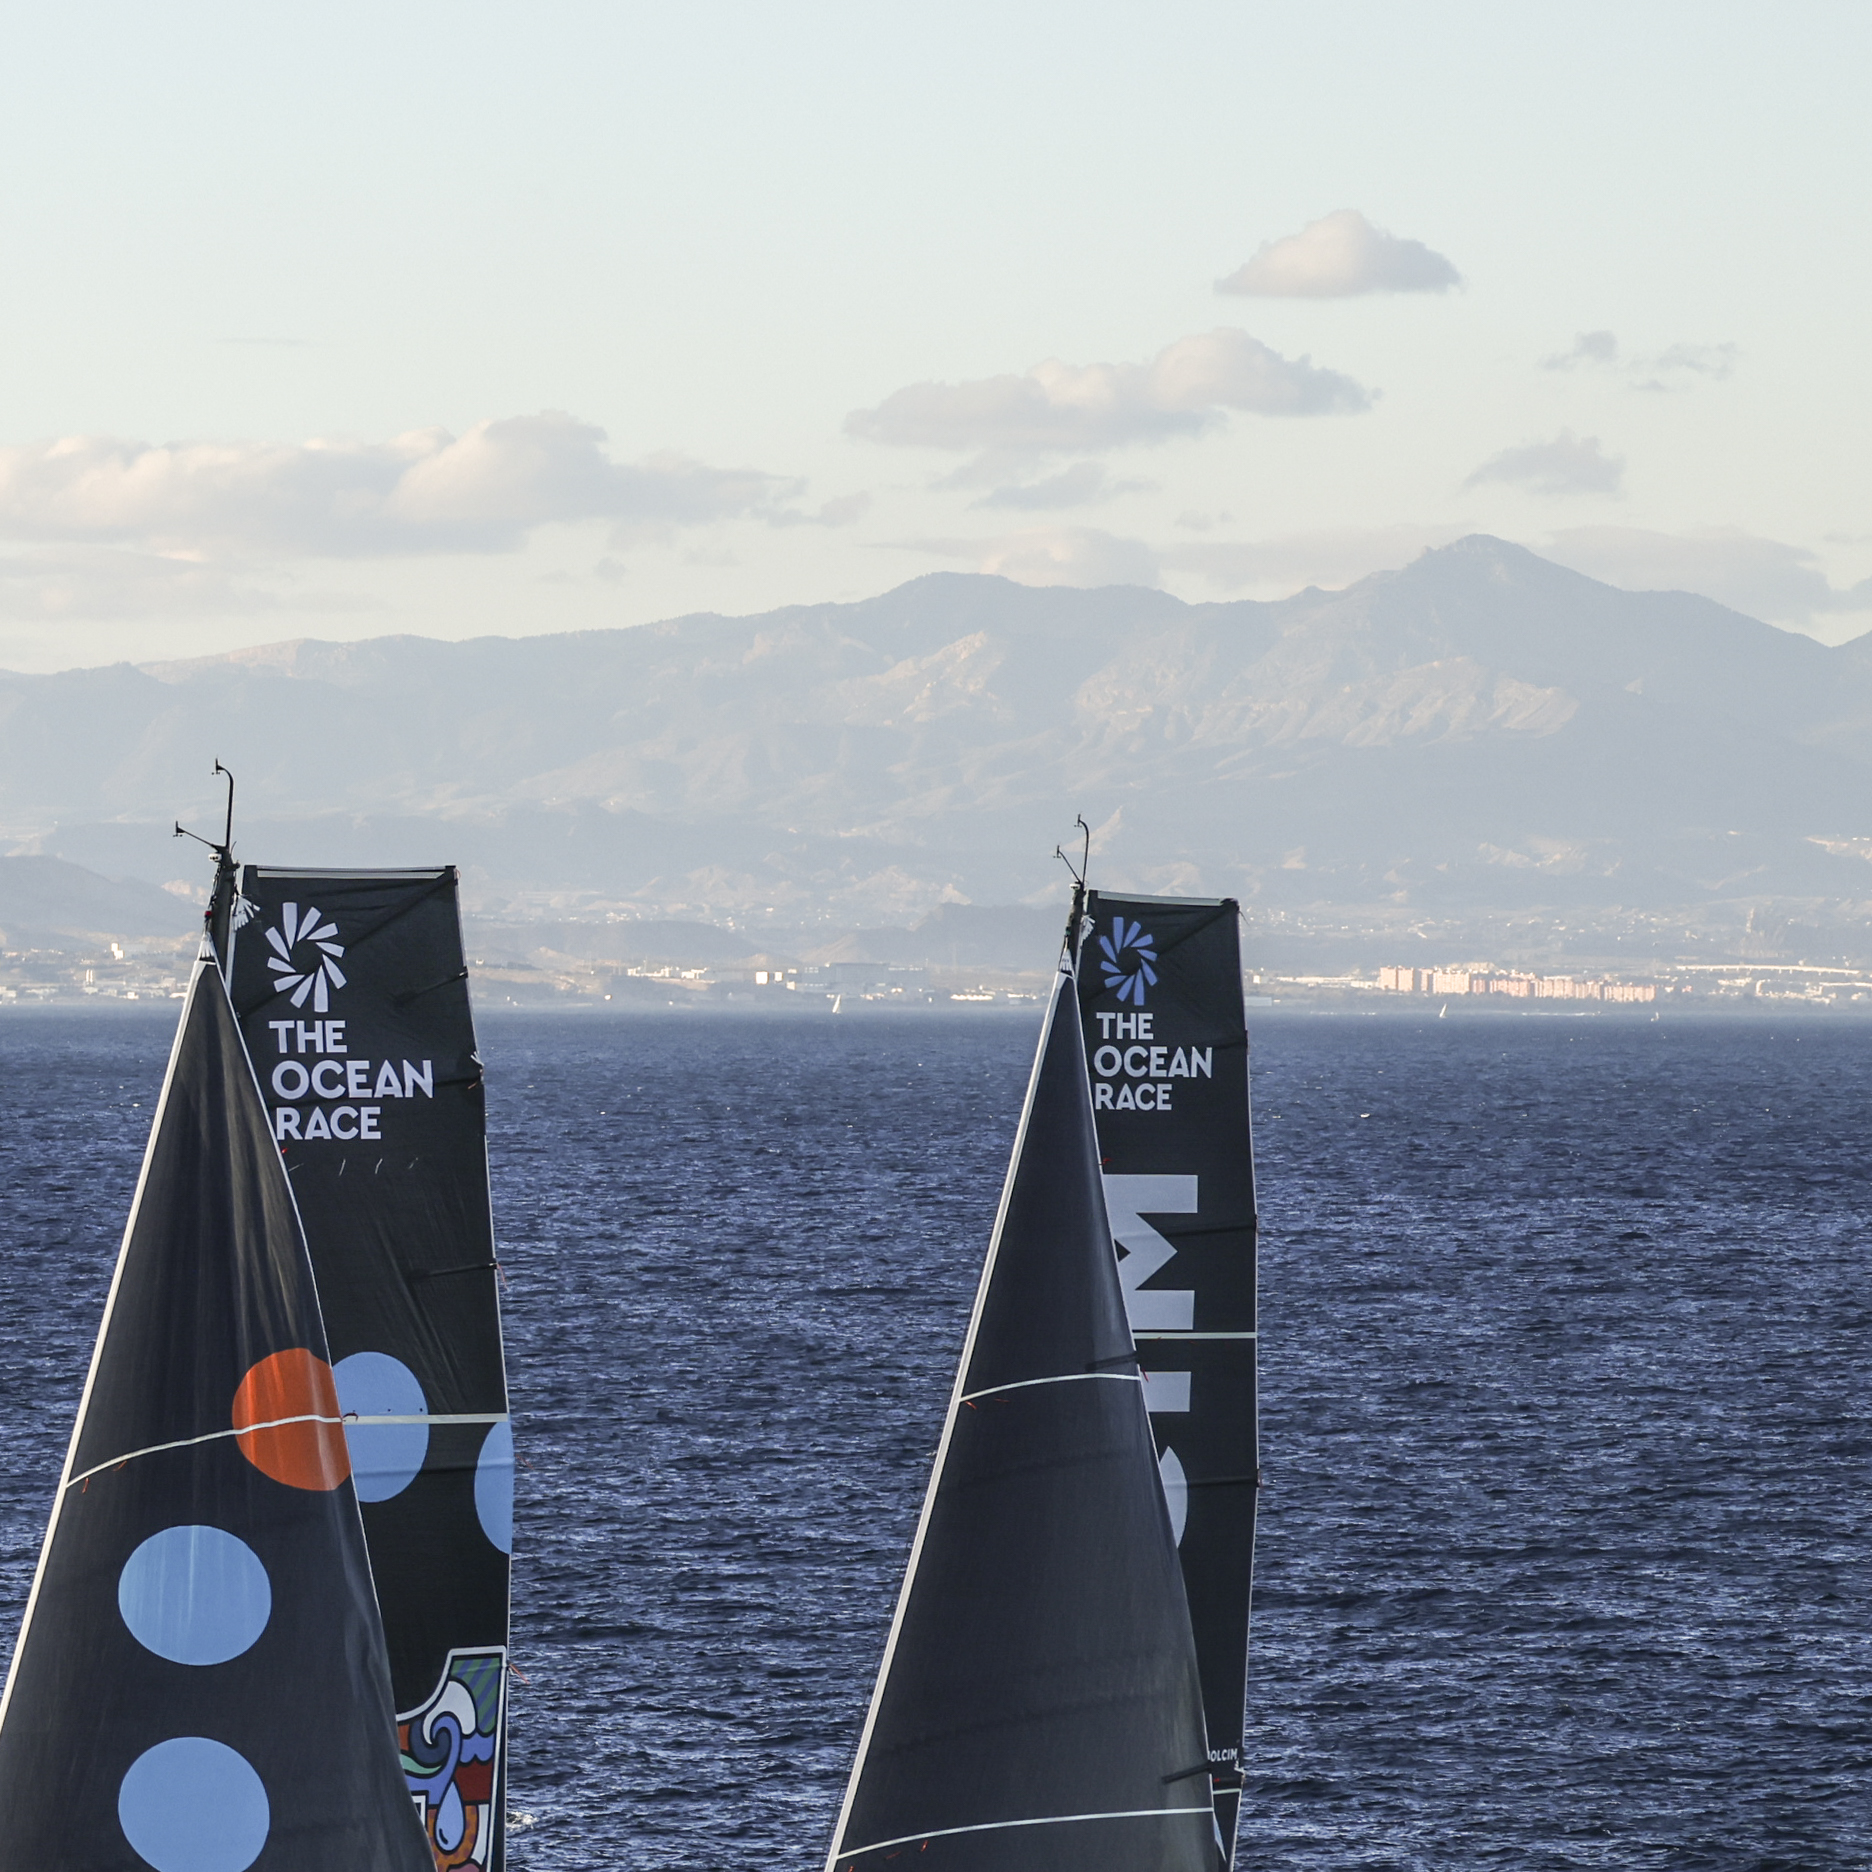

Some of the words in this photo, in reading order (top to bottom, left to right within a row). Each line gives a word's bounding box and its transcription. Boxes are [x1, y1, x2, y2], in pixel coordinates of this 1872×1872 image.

[269, 1020, 347, 1054] THE
[1096, 1012, 1154, 1040] THE
[272, 1059, 433, 1099] OCEAN
[1094, 1045, 1212, 1079] OCEAN
[1095, 1083, 1173, 1111] RACE
[276, 1106, 382, 1140] RACE
